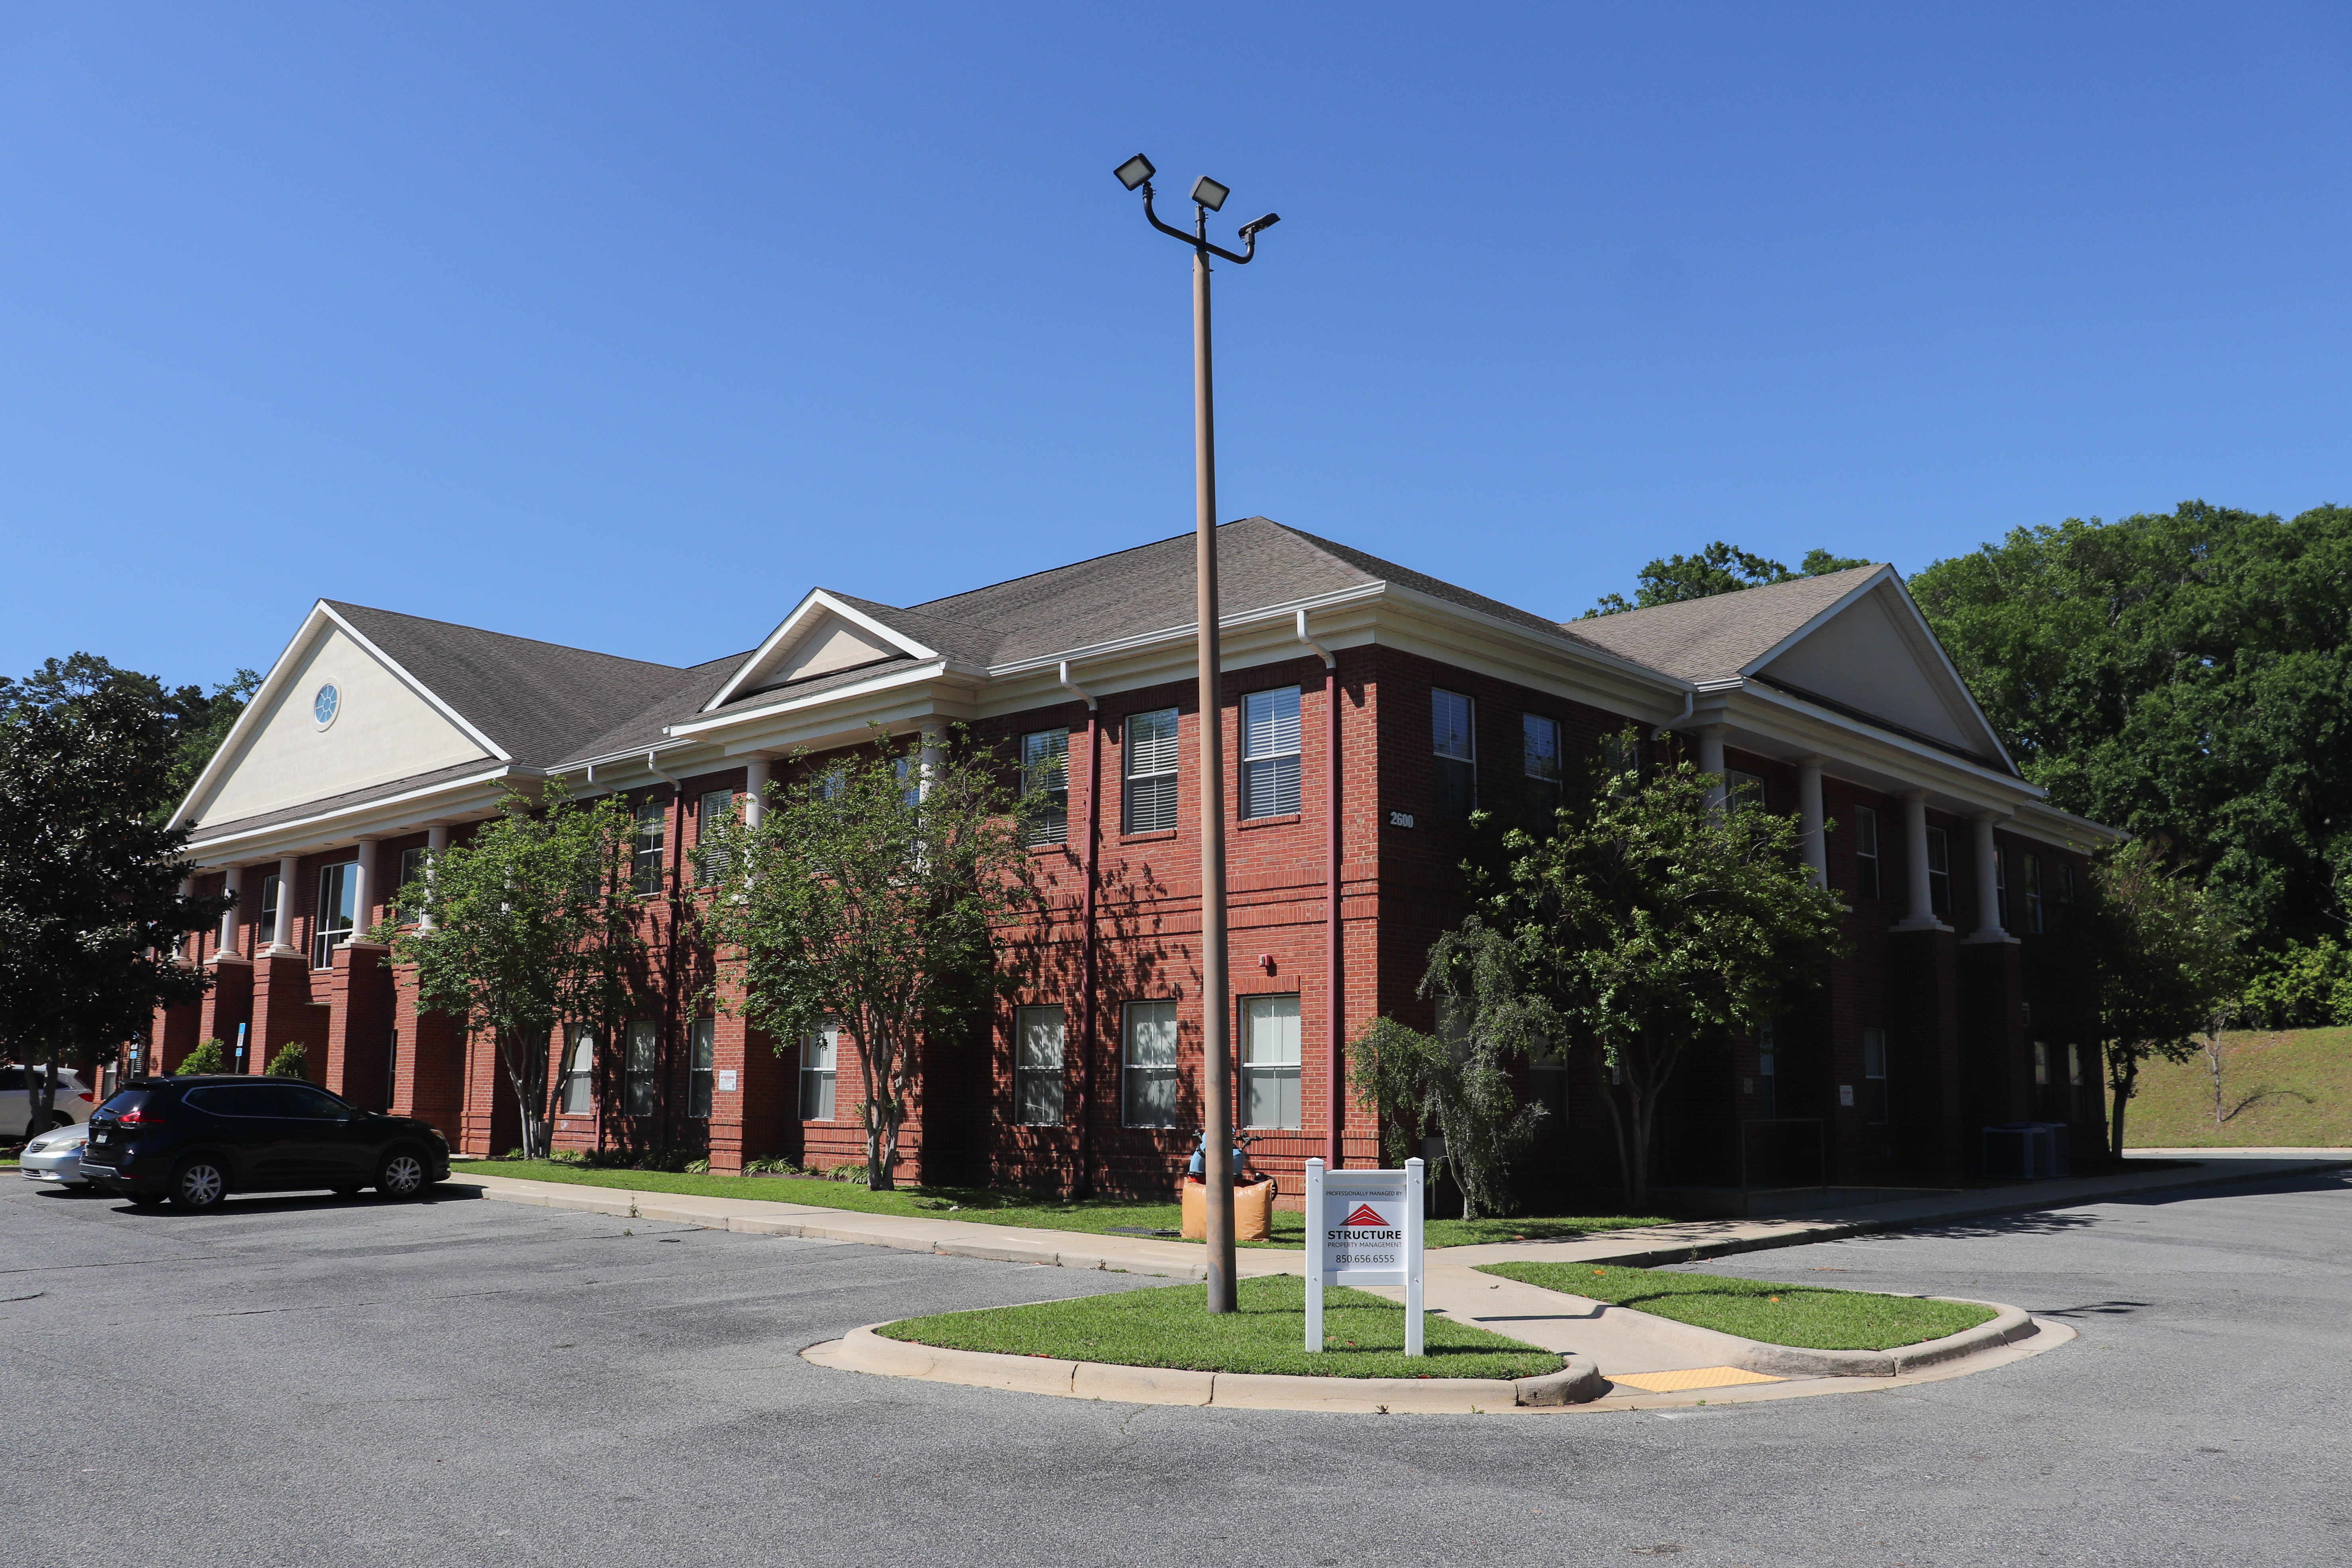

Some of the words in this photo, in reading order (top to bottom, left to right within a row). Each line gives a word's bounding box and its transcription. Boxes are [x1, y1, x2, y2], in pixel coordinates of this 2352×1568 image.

[1390, 812, 1413, 828] 2600
[1328, 1230, 1401, 1240] STRUCTURE
[1336, 1255, 1394, 1263] 850.656.6555
